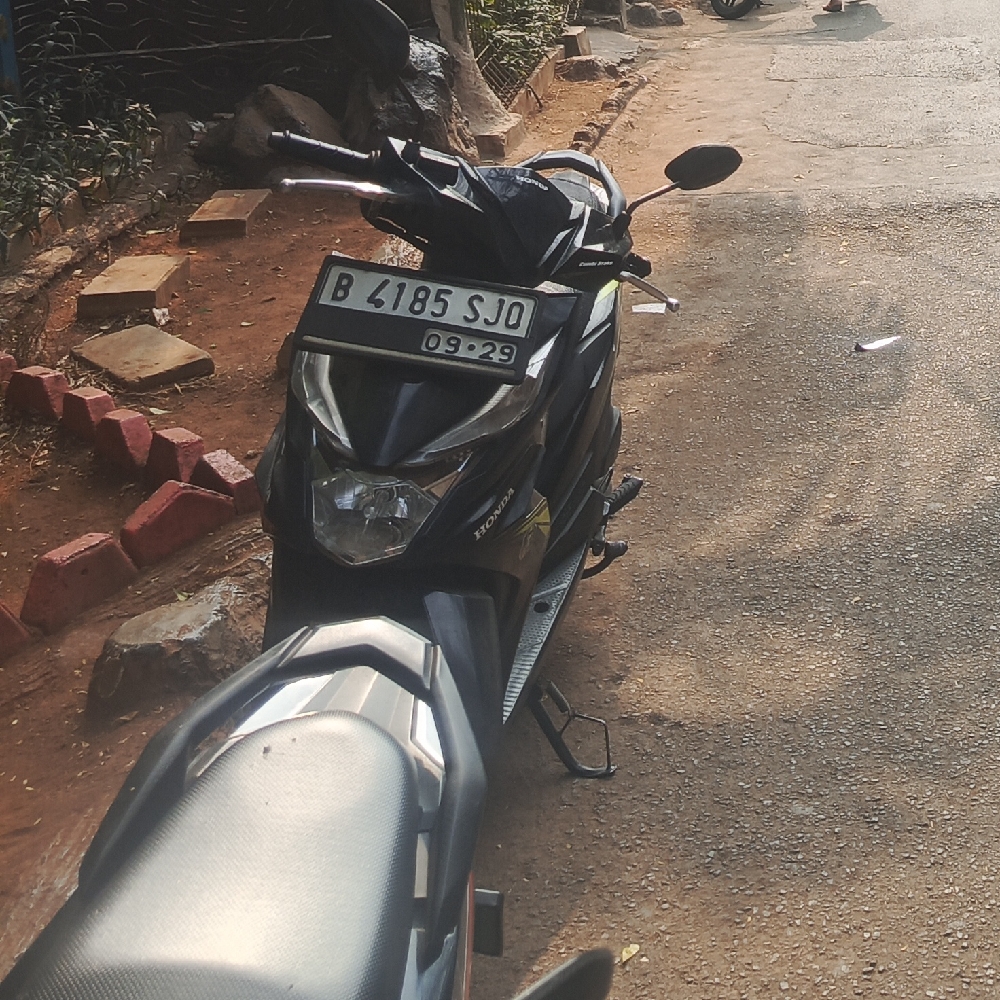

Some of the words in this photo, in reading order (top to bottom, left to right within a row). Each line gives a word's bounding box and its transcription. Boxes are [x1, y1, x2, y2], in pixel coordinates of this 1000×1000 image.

[515, 174, 549, 191] HONDA
[331, 272, 354, 302] B
[366, 278, 454, 319] 4185
[473, 487, 515, 541] HONDA
